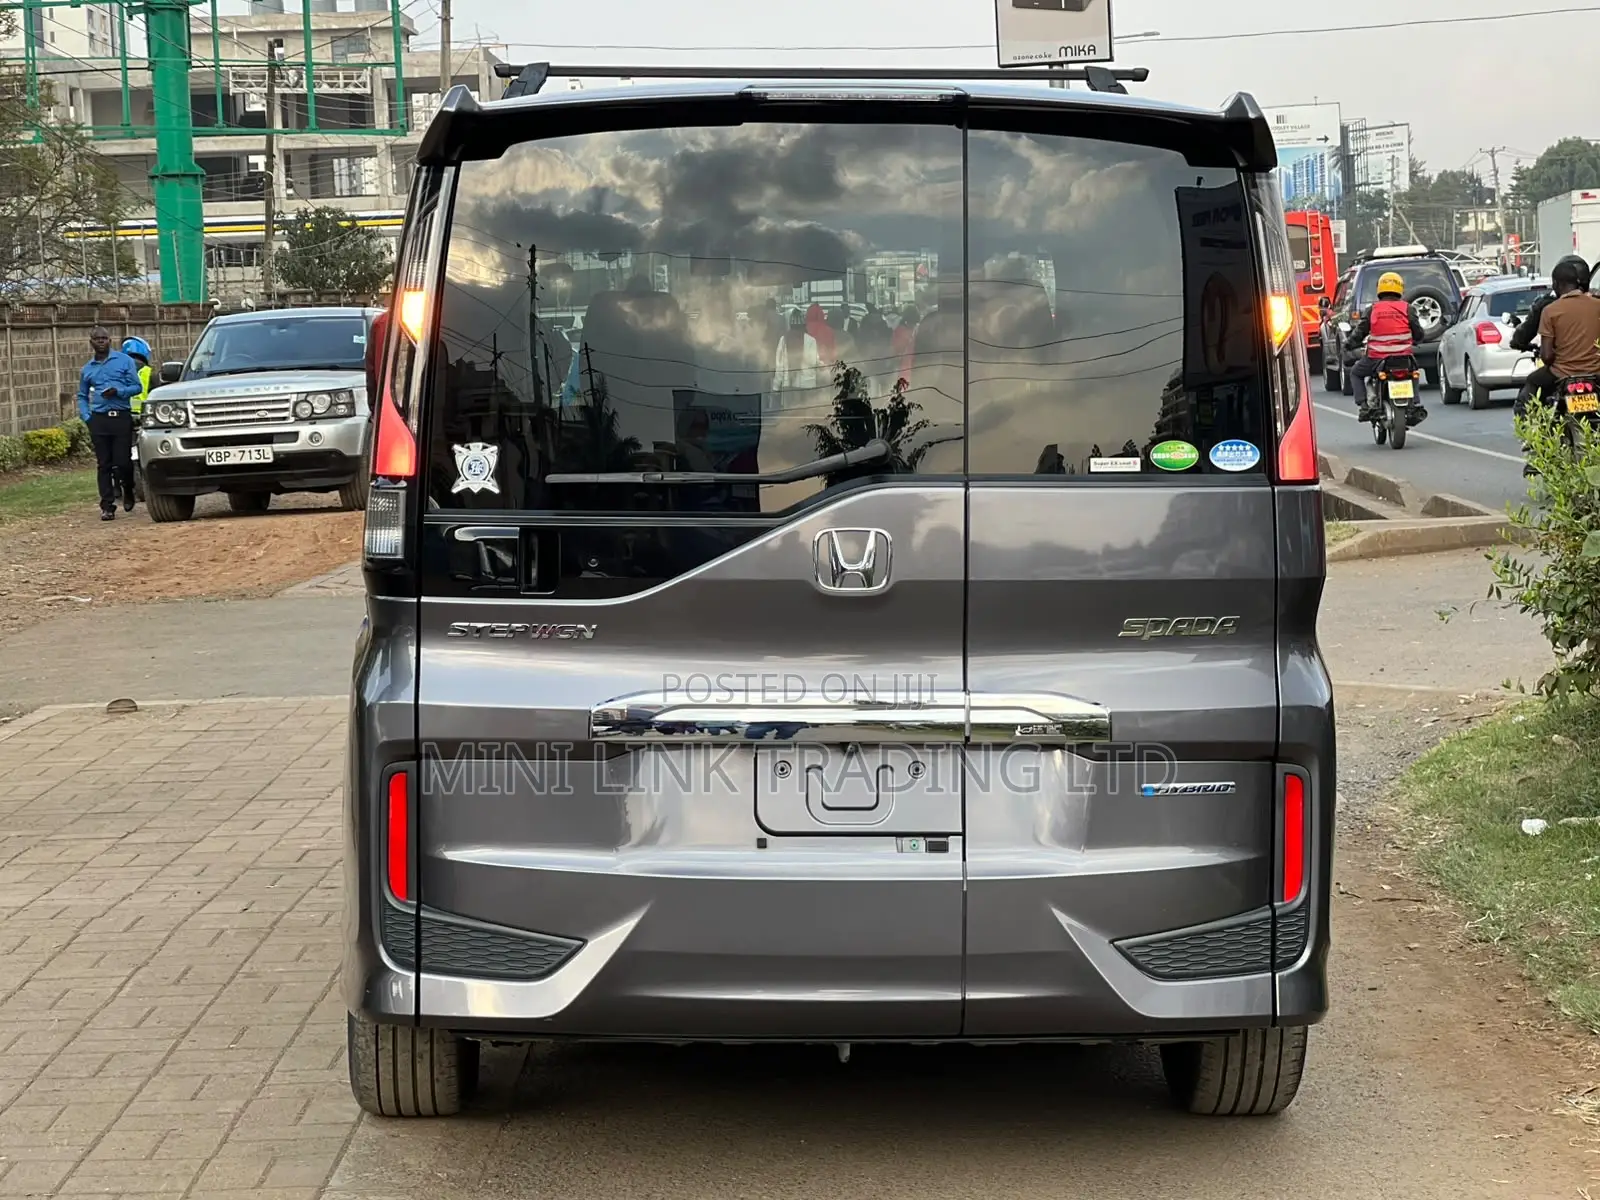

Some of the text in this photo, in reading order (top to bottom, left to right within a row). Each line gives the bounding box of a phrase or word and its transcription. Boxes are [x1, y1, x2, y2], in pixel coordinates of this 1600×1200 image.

[1059, 44, 1097, 57] MIKA
[207, 449, 271, 463] KBP 713L
[447, 621, 598, 640] STEPWGN
[1118, 615, 1241, 640] SPADA
[1155, 783, 1233, 794] HYBRID
